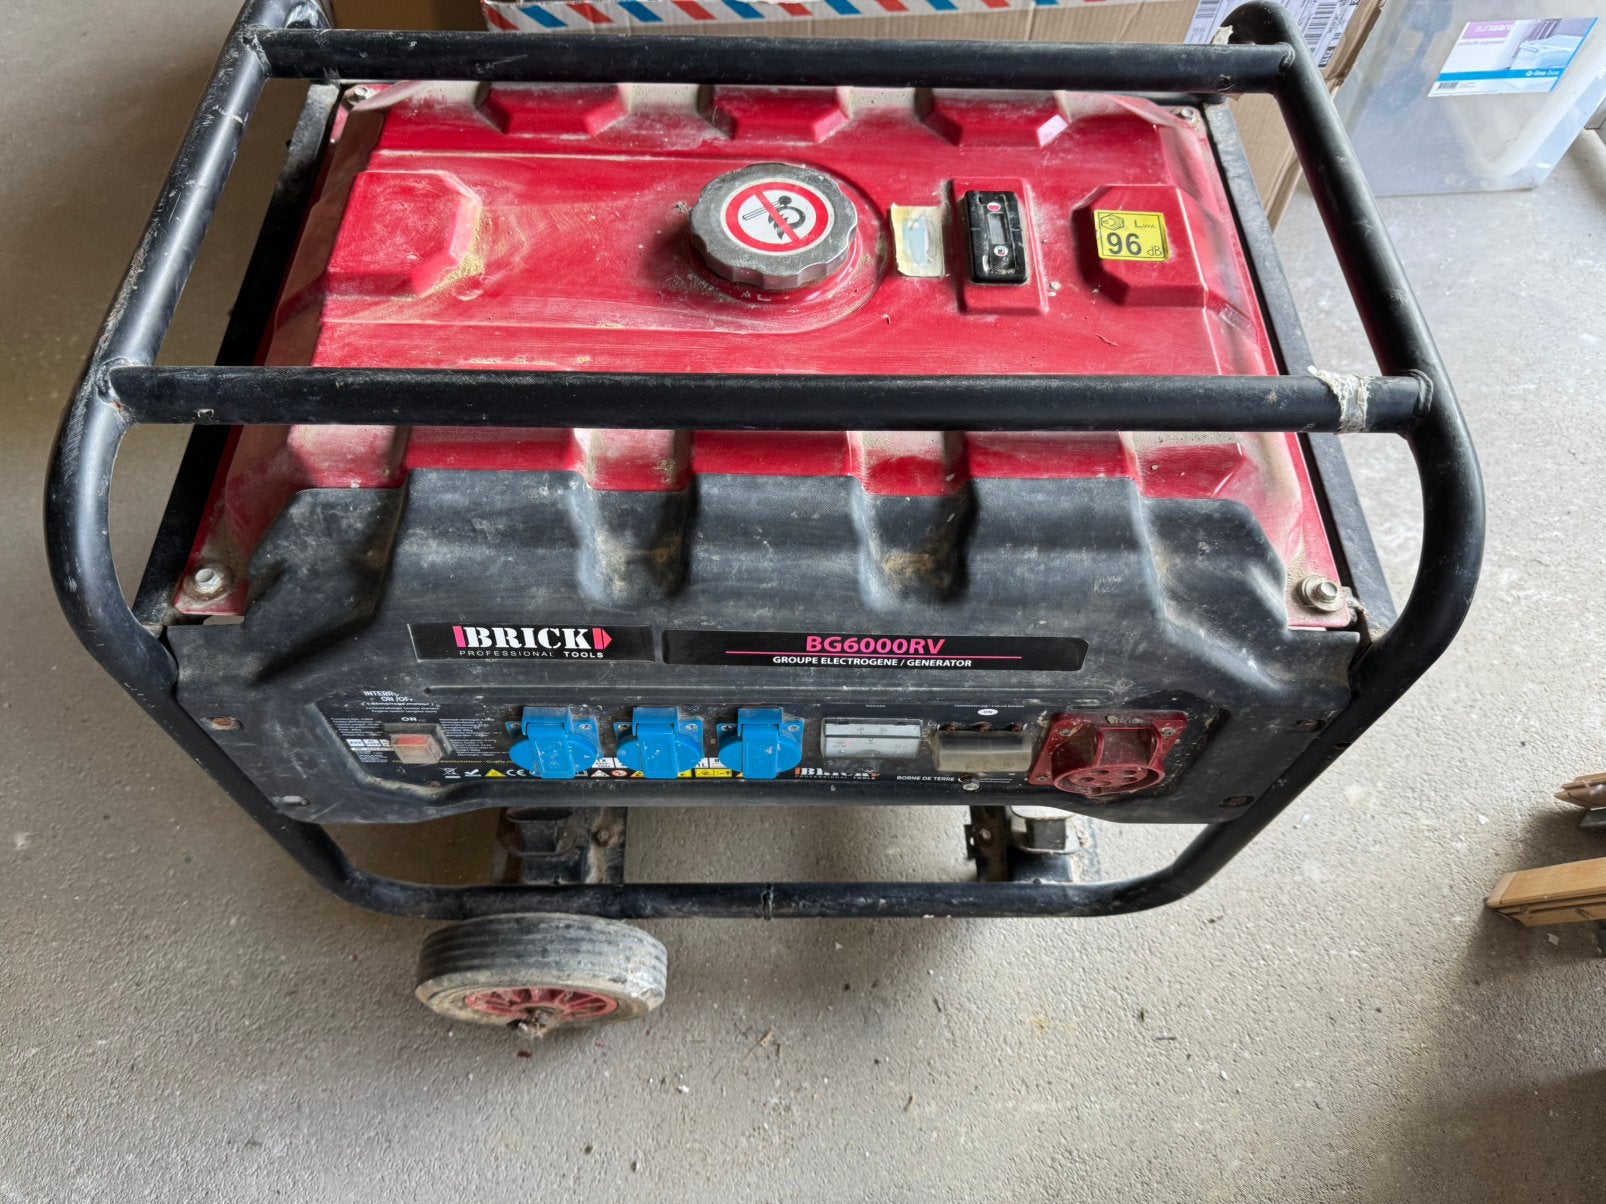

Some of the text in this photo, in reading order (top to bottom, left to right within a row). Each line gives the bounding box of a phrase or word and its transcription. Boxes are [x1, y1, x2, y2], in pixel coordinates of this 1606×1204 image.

[1106, 232, 1142, 256] 96
[1146, 244, 1162, 257] dB
[463, 626, 592, 650] BRICK
[805, 635, 946, 655] BG6000RV
[458, 650, 604, 659] PROFESSIONAL TOOLS
[773, 656, 818, 665] GROUPE
[820, 656, 898, 667] ELECTROGENE
[906, 657, 972, 668] GENERATOR
